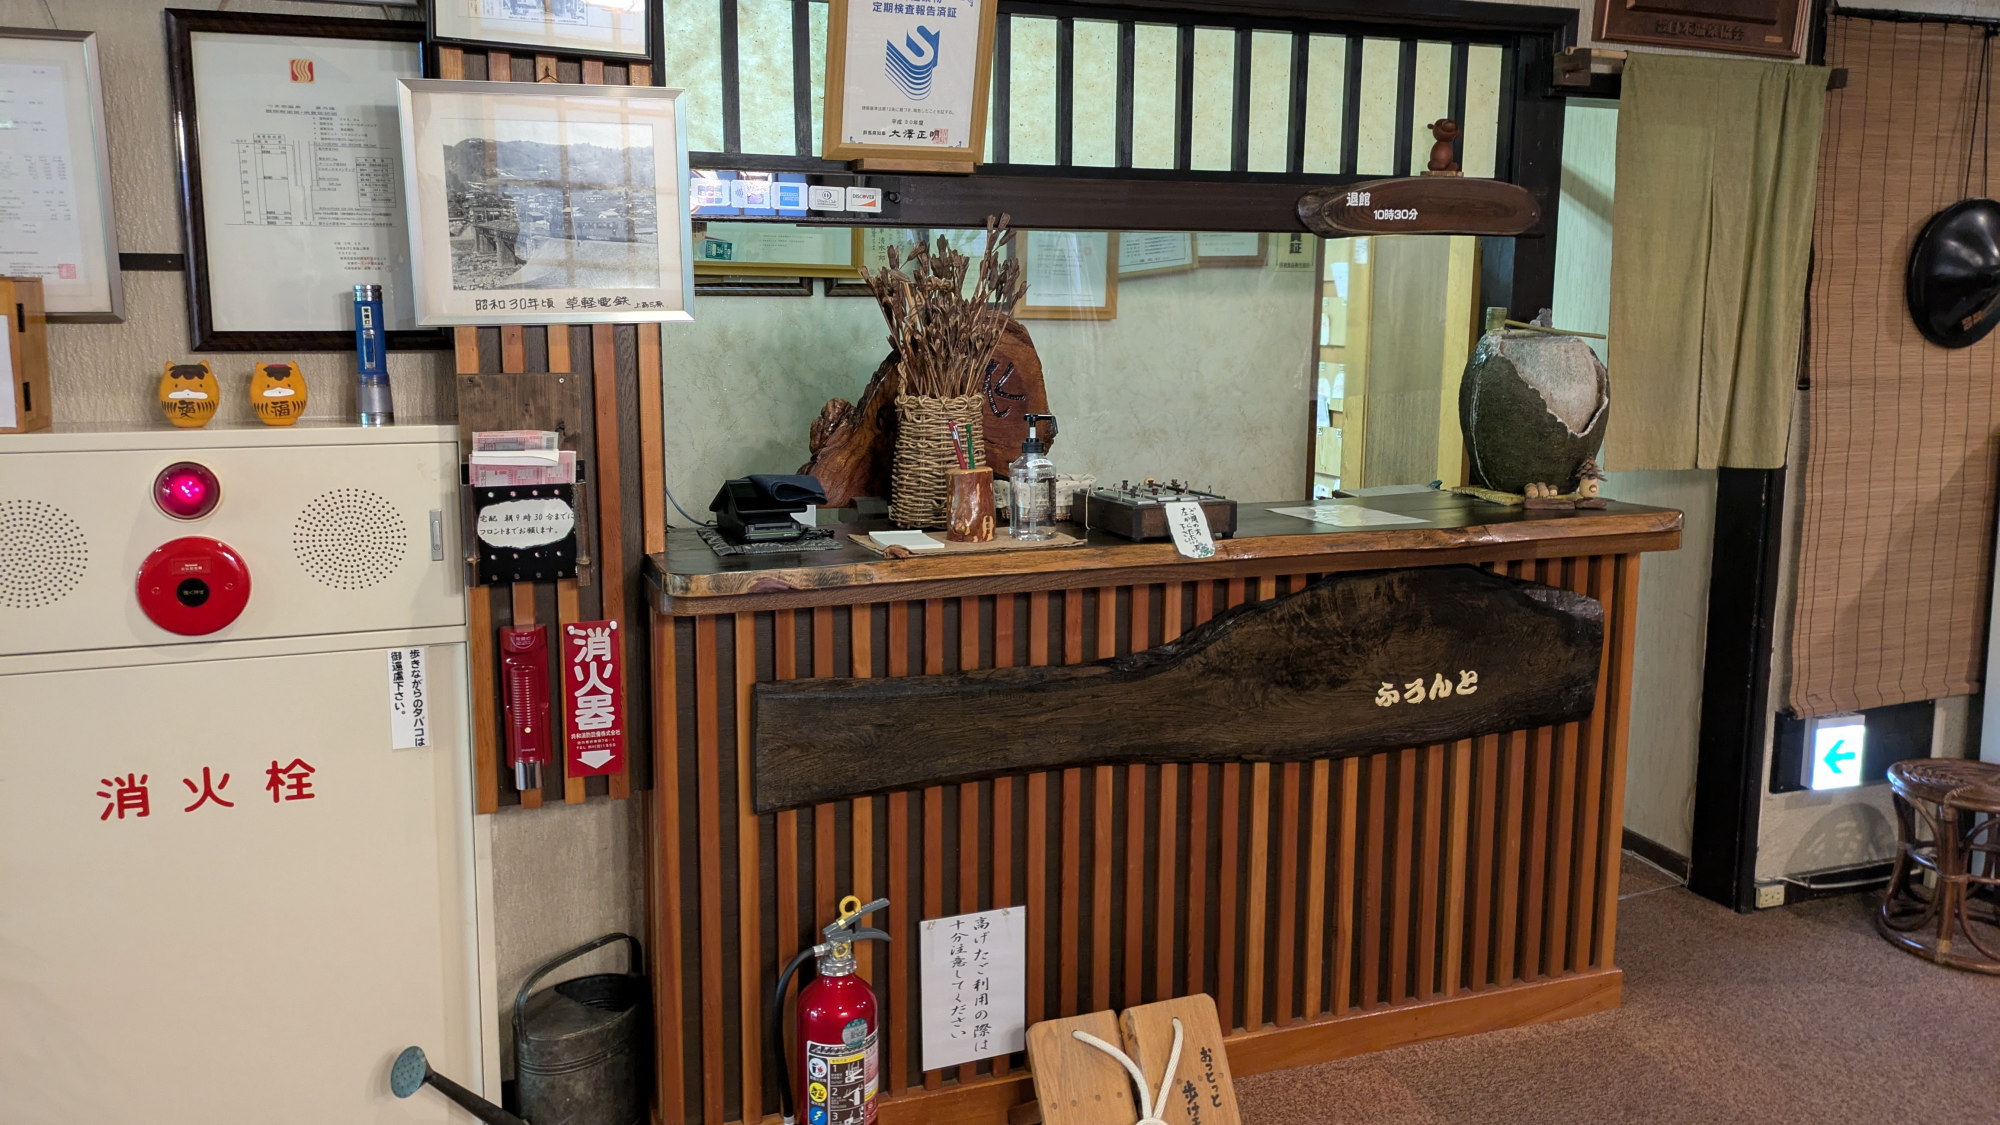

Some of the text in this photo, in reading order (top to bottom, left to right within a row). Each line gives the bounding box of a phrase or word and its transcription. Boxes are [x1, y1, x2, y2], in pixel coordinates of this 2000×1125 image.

[872, 1, 958, 18] 定期検査報告済証
[888, 128, 940, 140] 大澤正明
[1346, 191, 1371, 207] 退館
[1373, 208, 1419, 221] 10時30分
[475, 298, 556, 311] 昭和30年頃
[564, 295, 631, 310] 草軽電鉄
[270, 400, 291, 417] 福
[479, 514, 498, 523] 宅配
[390, 651, 406, 715] 御遠慮下さい。
[573, 626, 616, 731] 消火器
[409, 648, 426, 747] 歩きながらのタバコは
[96, 758, 316, 821] 消火栓
[949, 919, 969, 1039] 十分注意してください
[972, 916, 992, 1053] 高げたご利用の際は
[832, 1065, 837, 1073] 1
[1200, 1046, 1222, 1108] おっとっと
[831, 1087, 838, 1096] 2
[831, 1112, 838, 1121] 3
